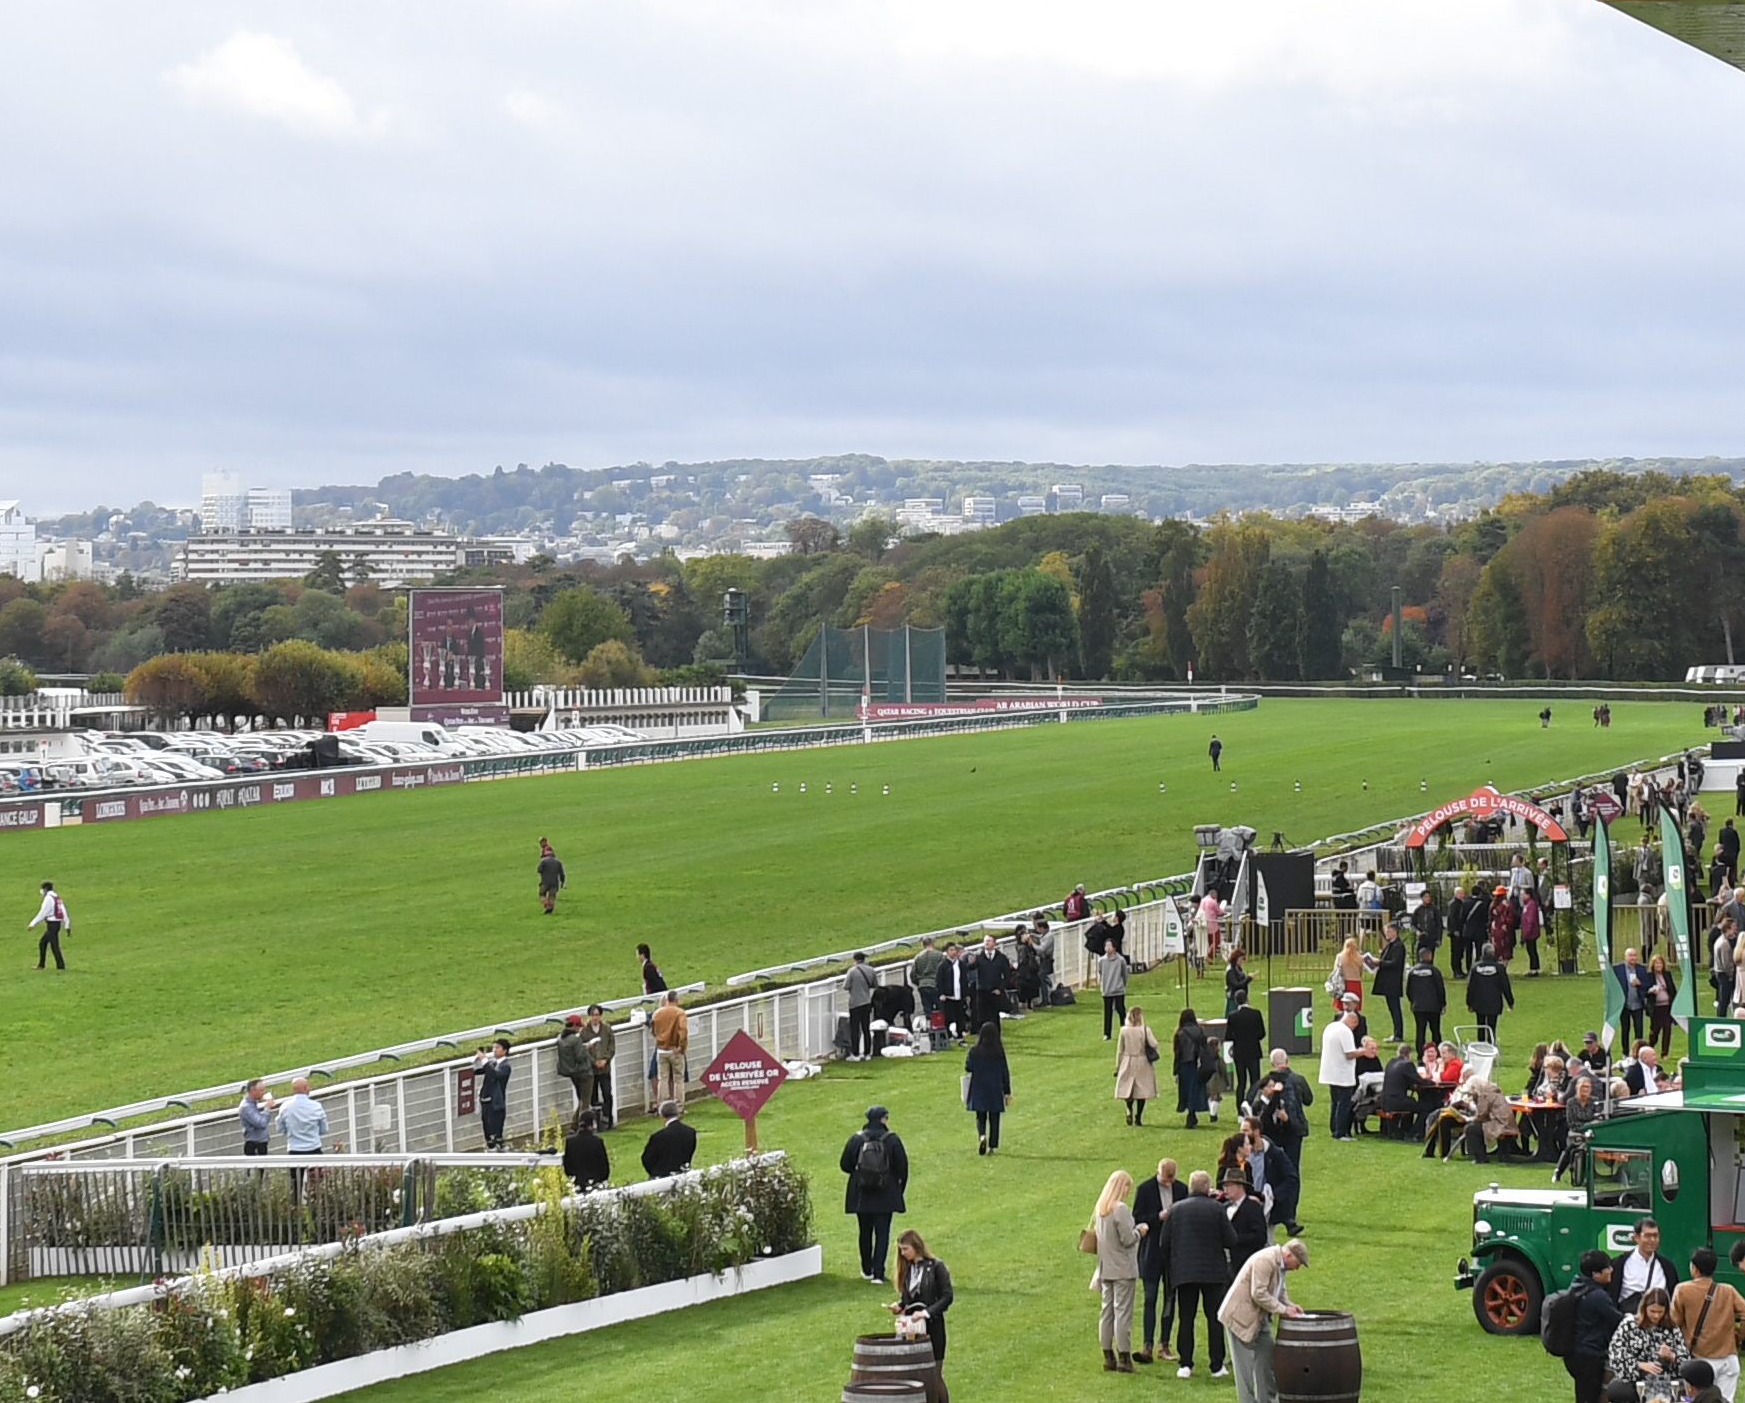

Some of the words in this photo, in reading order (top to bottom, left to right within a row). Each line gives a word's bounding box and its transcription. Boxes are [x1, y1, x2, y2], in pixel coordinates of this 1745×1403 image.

[1417, 801, 1467, 836] PELOUSE
[1470, 797, 1487, 808] DE
[1491, 797, 1551, 830] L'ARRIVÉE
[724, 1060, 762, 1071] PELOUSE
[708, 1072, 721, 1082] DE
[723, 1069, 764, 1081] L'ARRIVÉE
[766, 1069, 779, 1077] OR
